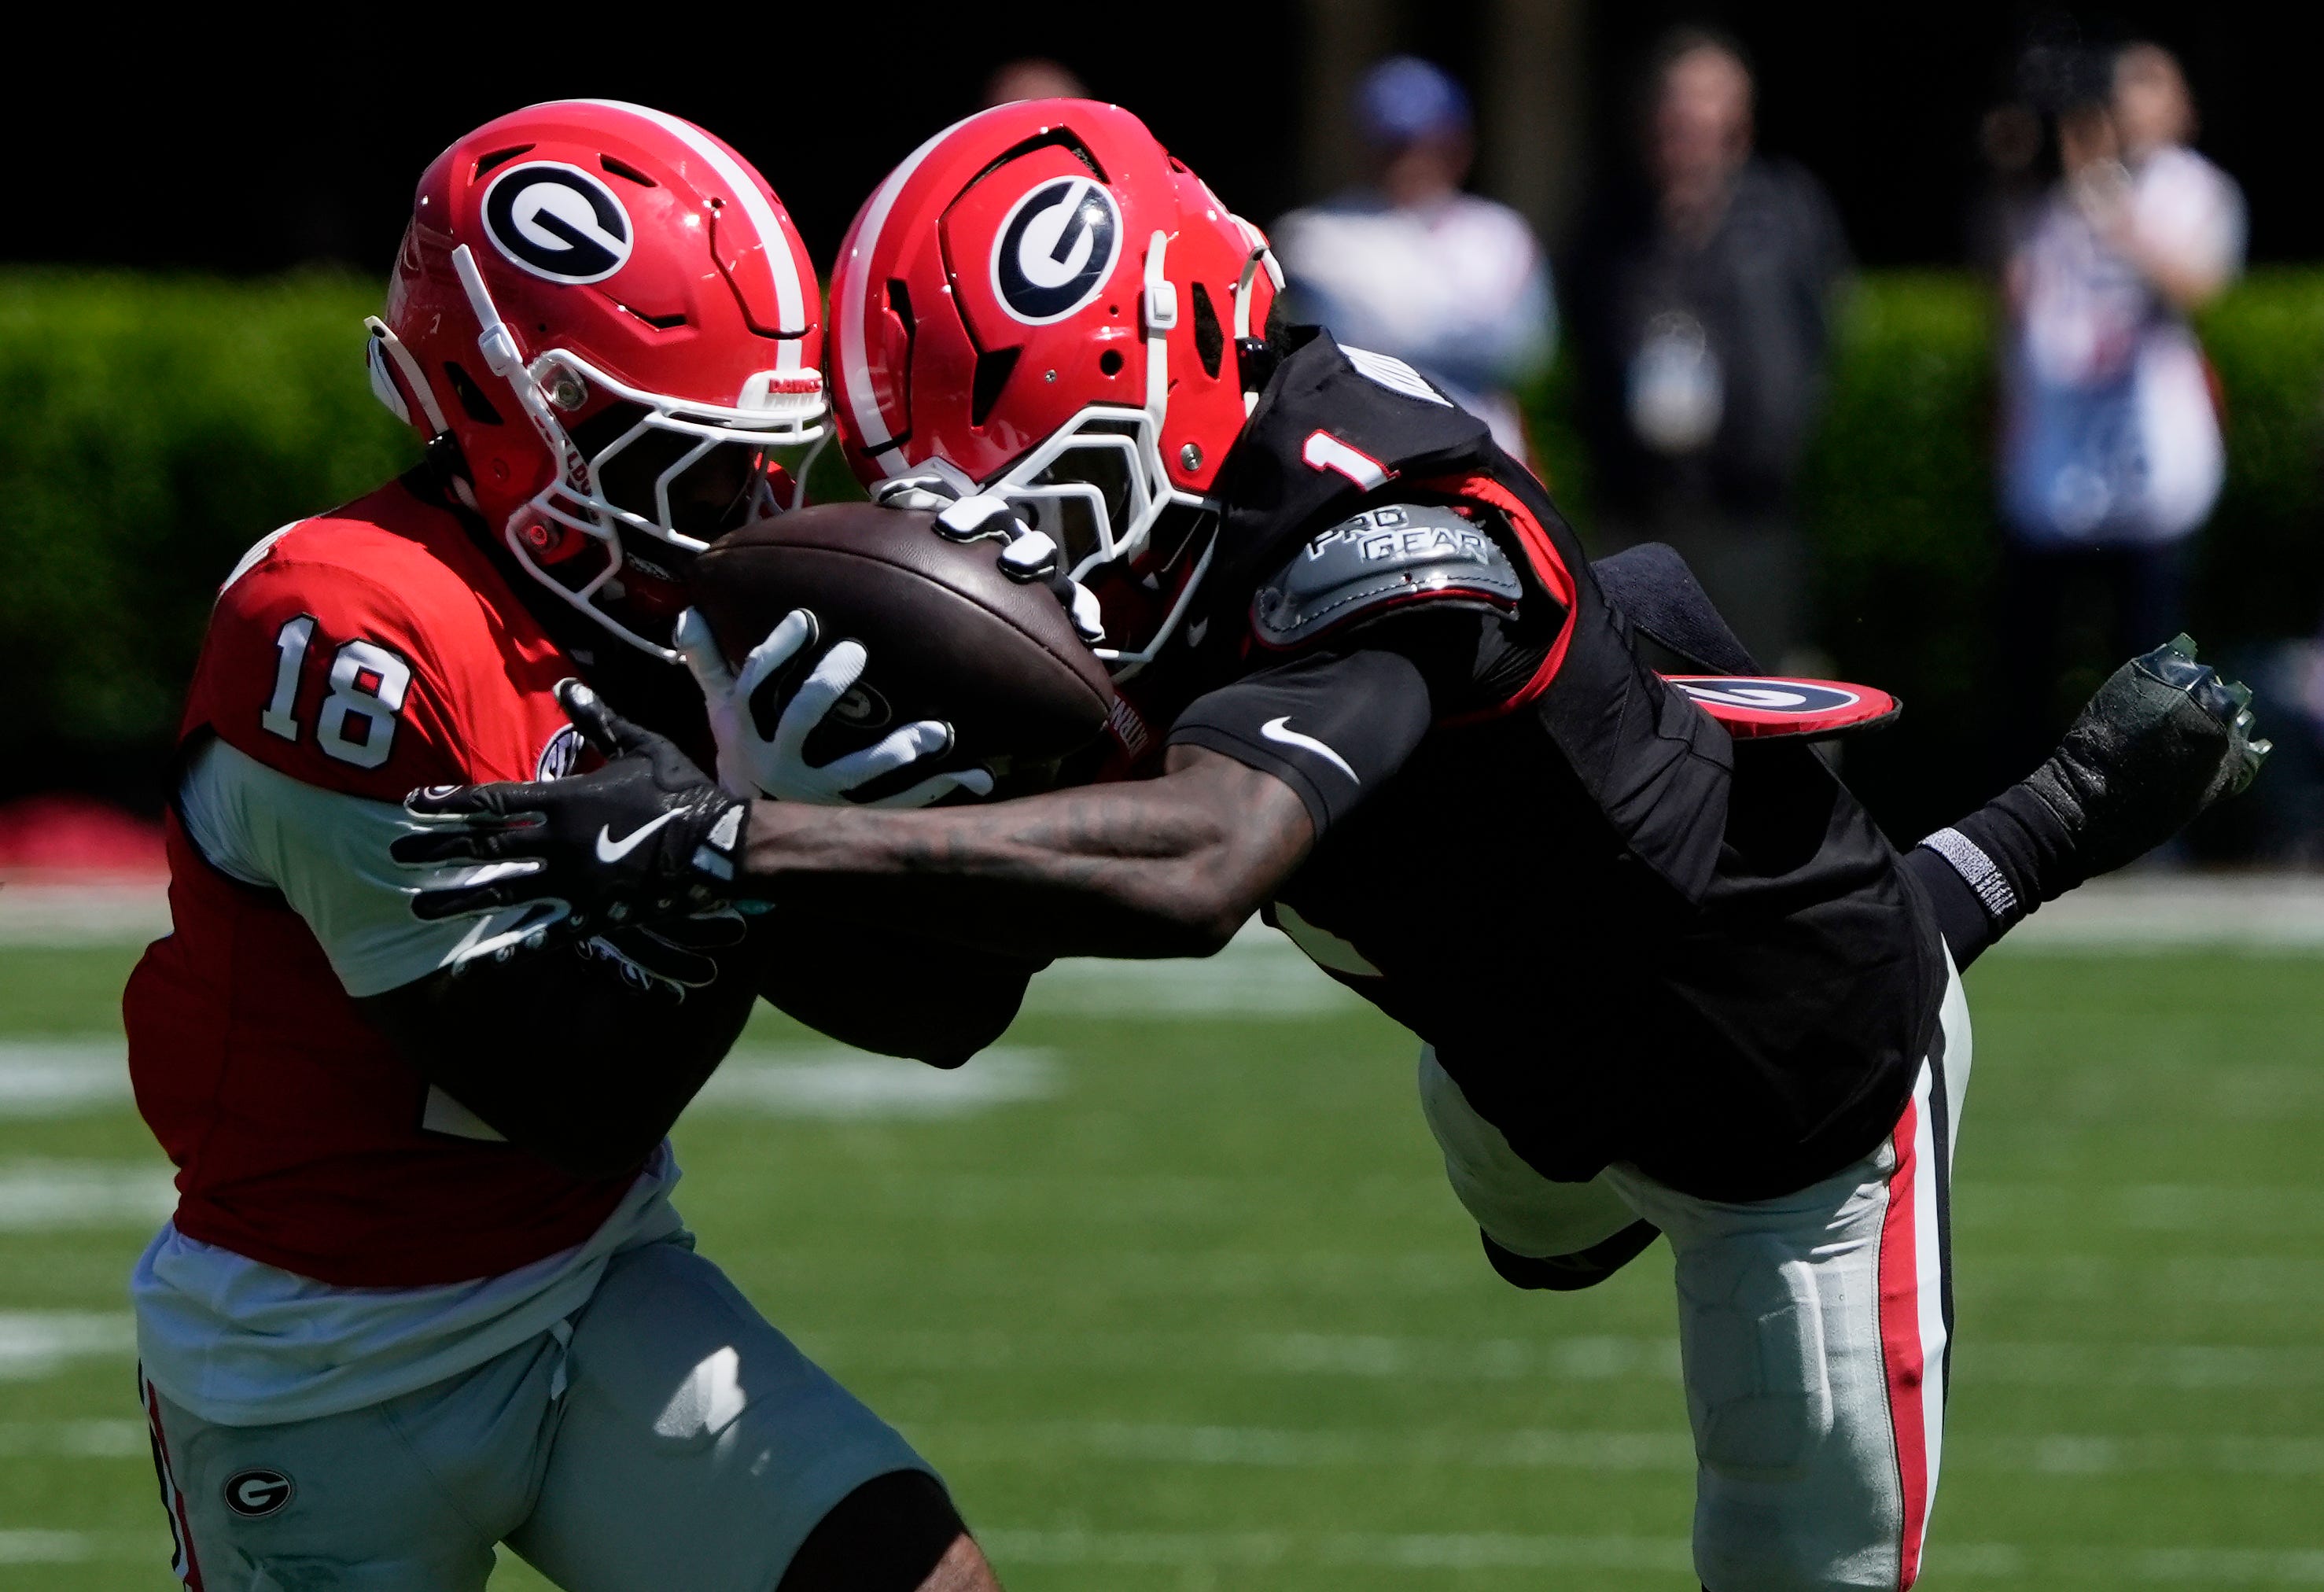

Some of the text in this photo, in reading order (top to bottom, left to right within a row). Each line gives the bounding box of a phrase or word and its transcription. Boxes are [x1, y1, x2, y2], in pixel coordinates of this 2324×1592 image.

[484, 164, 630, 279] G
[995, 179, 1119, 321] G
[1302, 429, 1401, 493] 1
[1356, 527, 1489, 566] GEAR
[262, 611, 414, 770] 18
[223, 1468, 293, 1517] G
